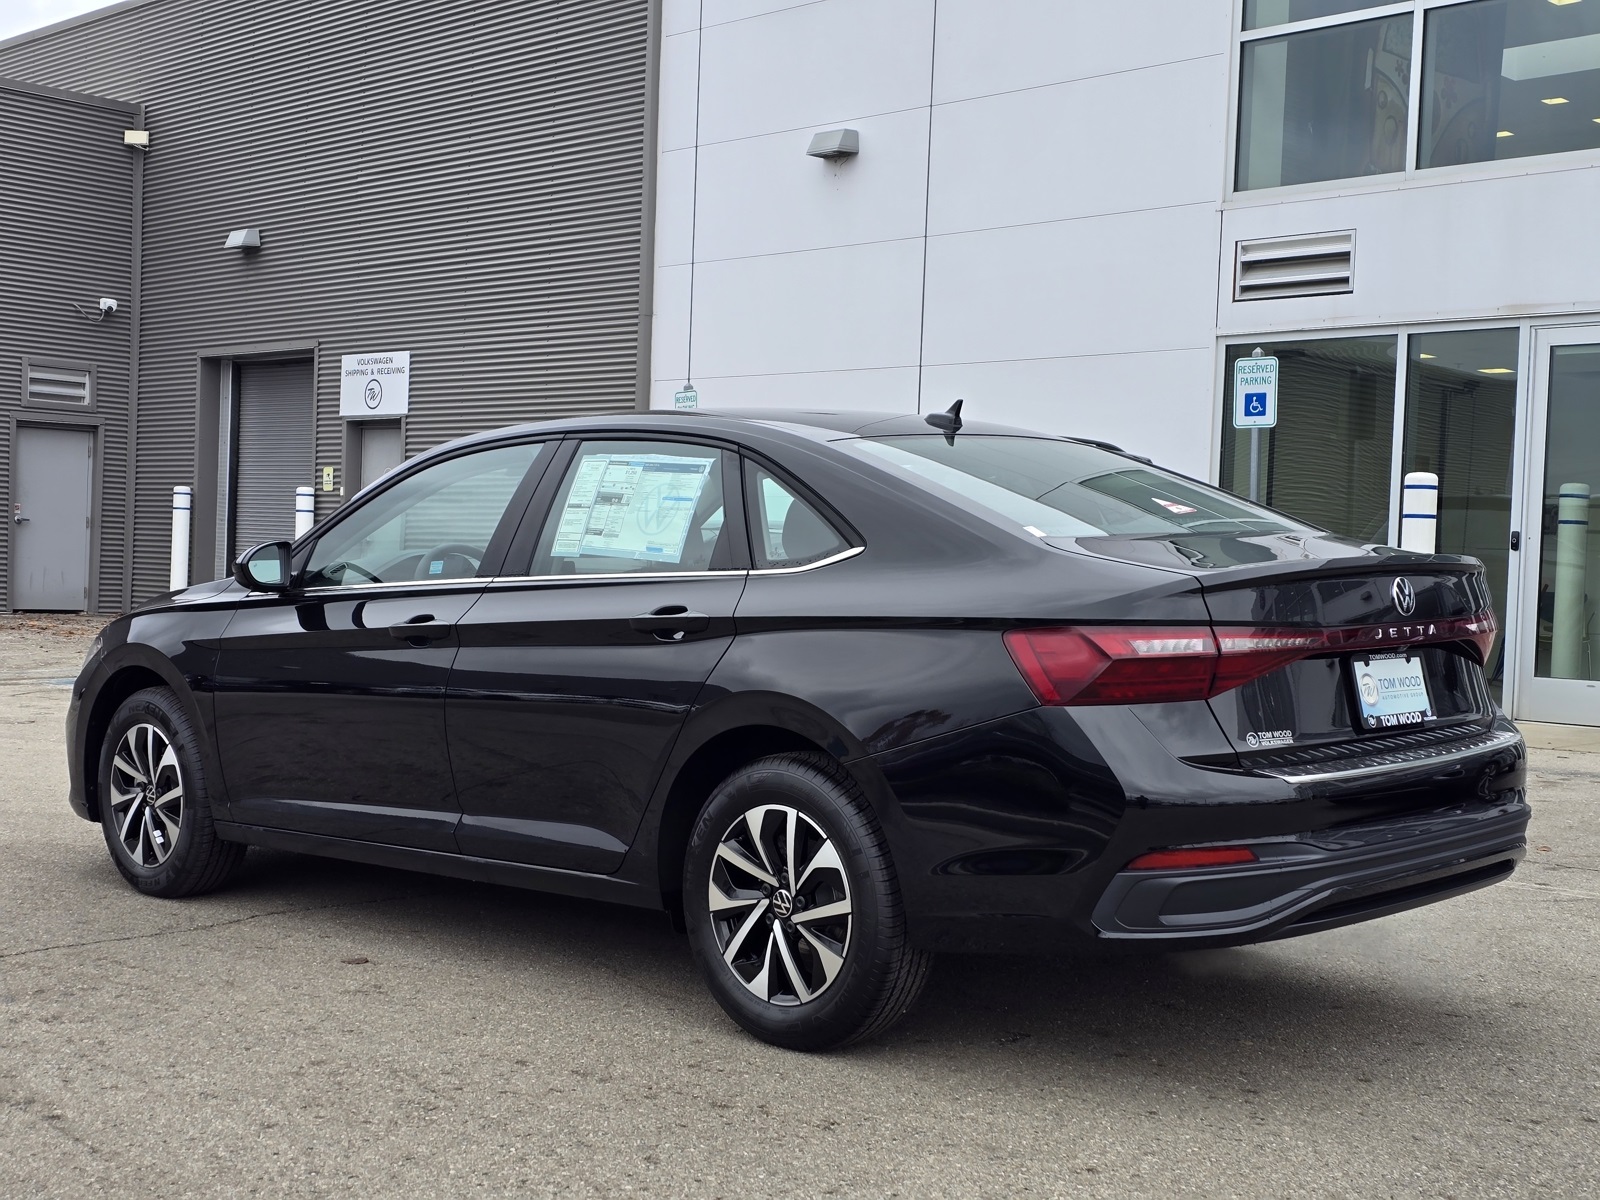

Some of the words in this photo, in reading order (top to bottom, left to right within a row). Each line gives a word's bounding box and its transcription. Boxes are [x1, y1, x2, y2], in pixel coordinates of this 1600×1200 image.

[357, 357, 393, 365] VOLKSWAGEN
[345, 368, 369, 377] SHIPPING
[377, 366, 405, 375] RECEIVING
[1238, 364, 1274, 374] RESERVED
[1240, 376, 1272, 386] PARKING
[1375, 624, 1437, 639] JETTA
[1378, 677, 1396, 689] TOM
[1397, 675, 1422, 688] WOOD
[1380, 714, 1398, 727] TOM
[1398, 711, 1422, 724] WOOD
